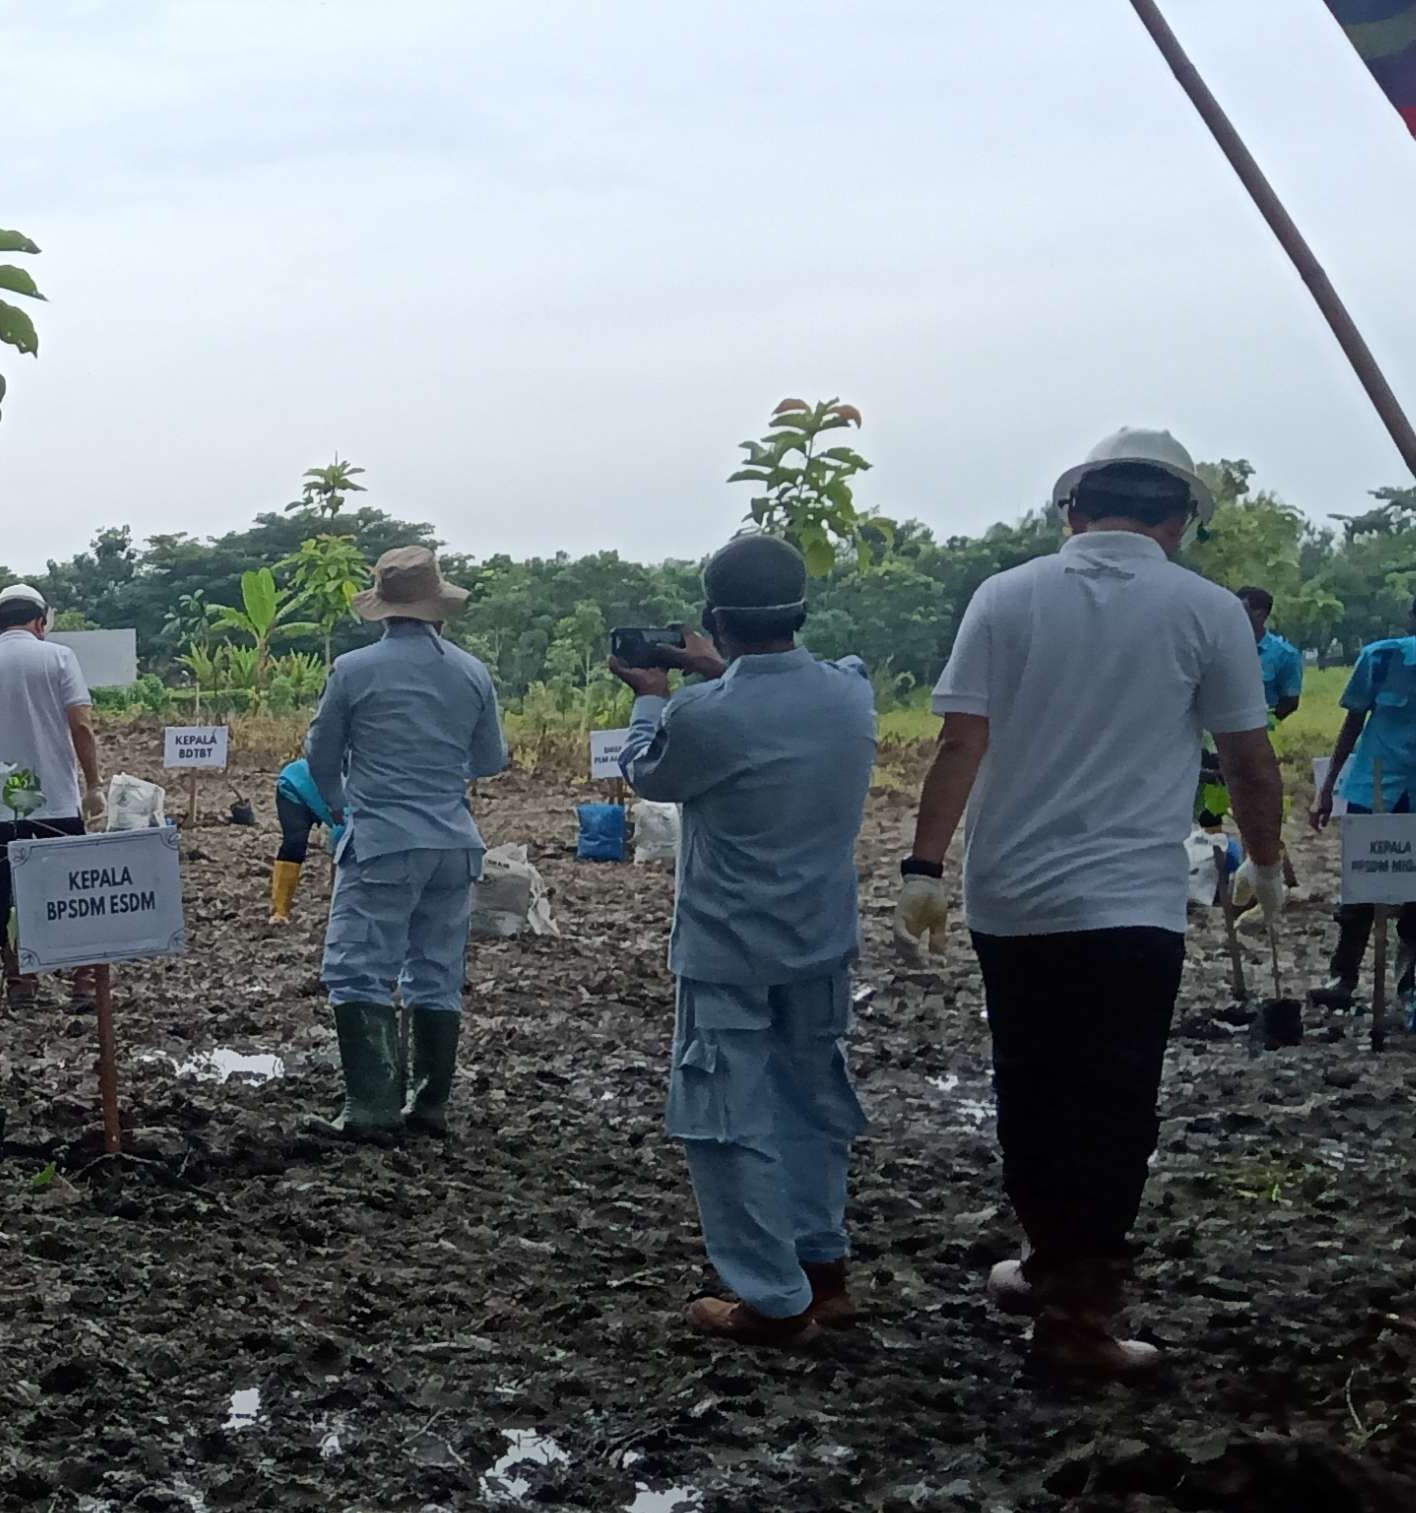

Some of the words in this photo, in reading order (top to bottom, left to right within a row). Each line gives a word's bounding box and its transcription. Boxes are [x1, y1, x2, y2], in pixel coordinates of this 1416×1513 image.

[176, 735, 217, 745] KEPALA
[179, 748, 212, 759] BDTBT
[1370, 840, 1412, 854] KEPALA
[69, 866, 133, 891] KEPALA
[47, 896, 106, 921] BPSDM
[110, 891, 156, 914] ESDM
